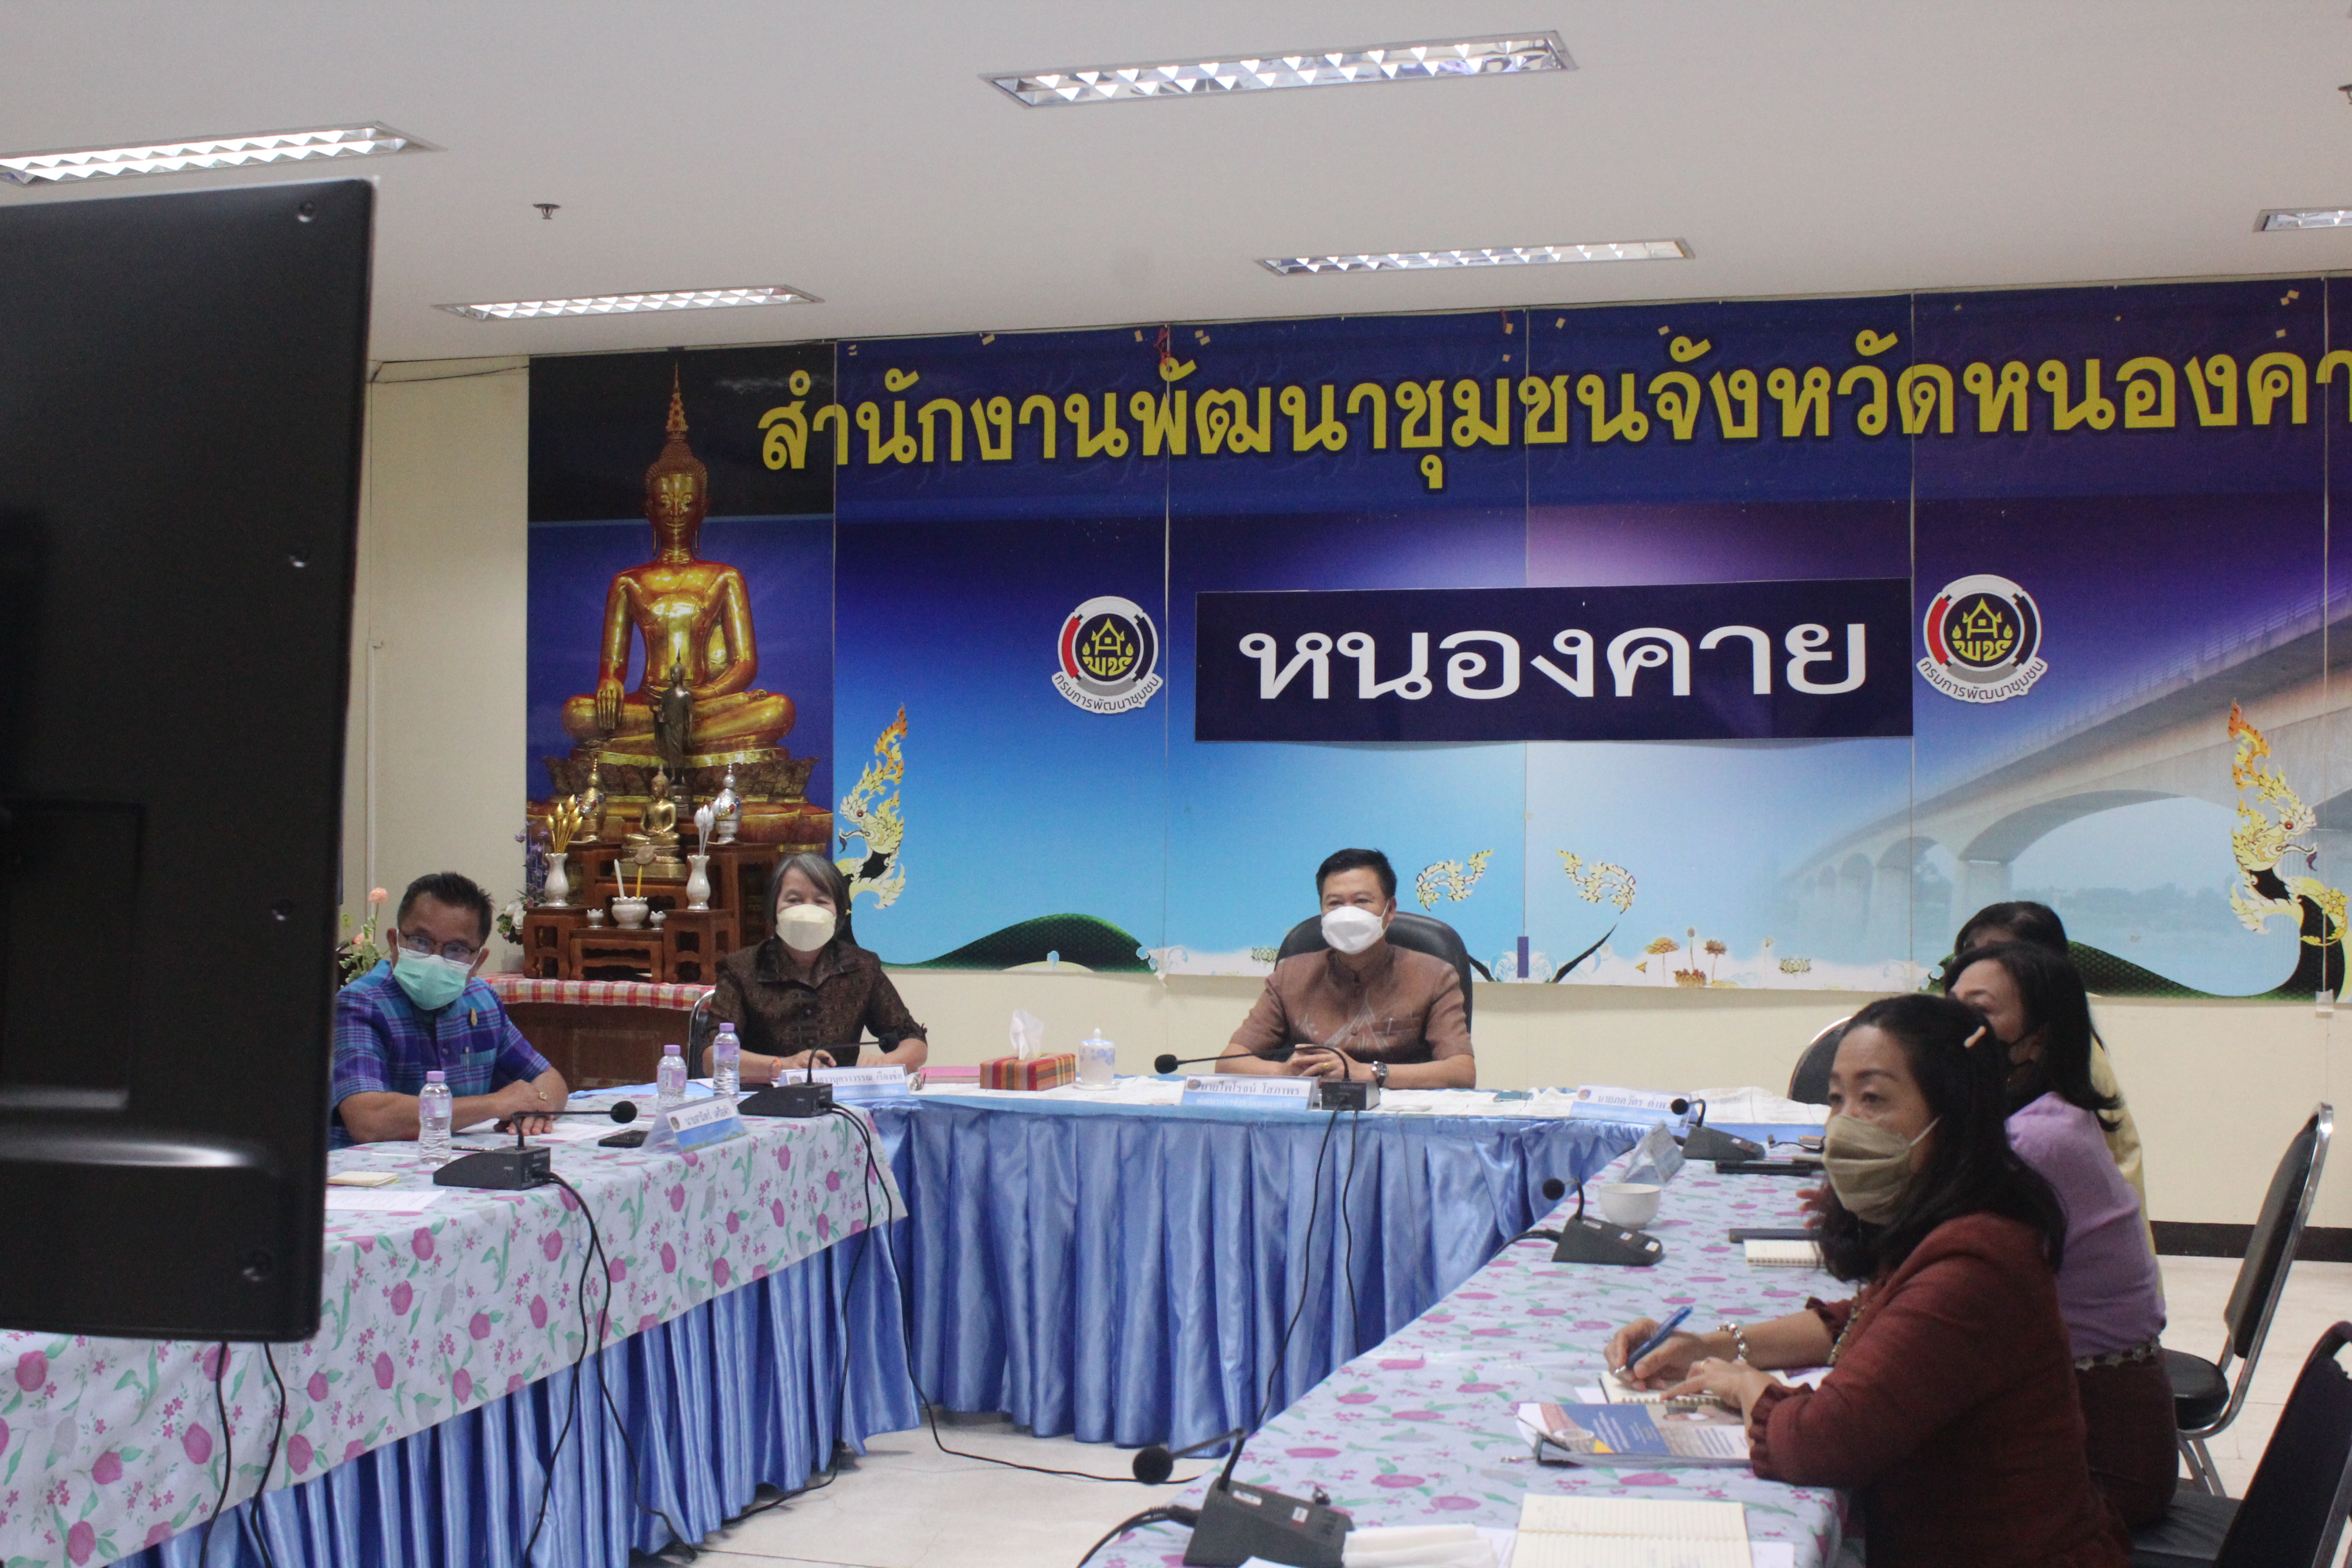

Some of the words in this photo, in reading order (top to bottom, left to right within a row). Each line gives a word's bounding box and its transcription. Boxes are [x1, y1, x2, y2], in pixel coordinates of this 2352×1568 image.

[1239, 623, 1867, 701] หนองคาย
[1920, 660, 2044, 700] กรมการพัฒนาชุมชน
[1054, 674, 1160, 710] กรมการพัฒนาชุมชน
